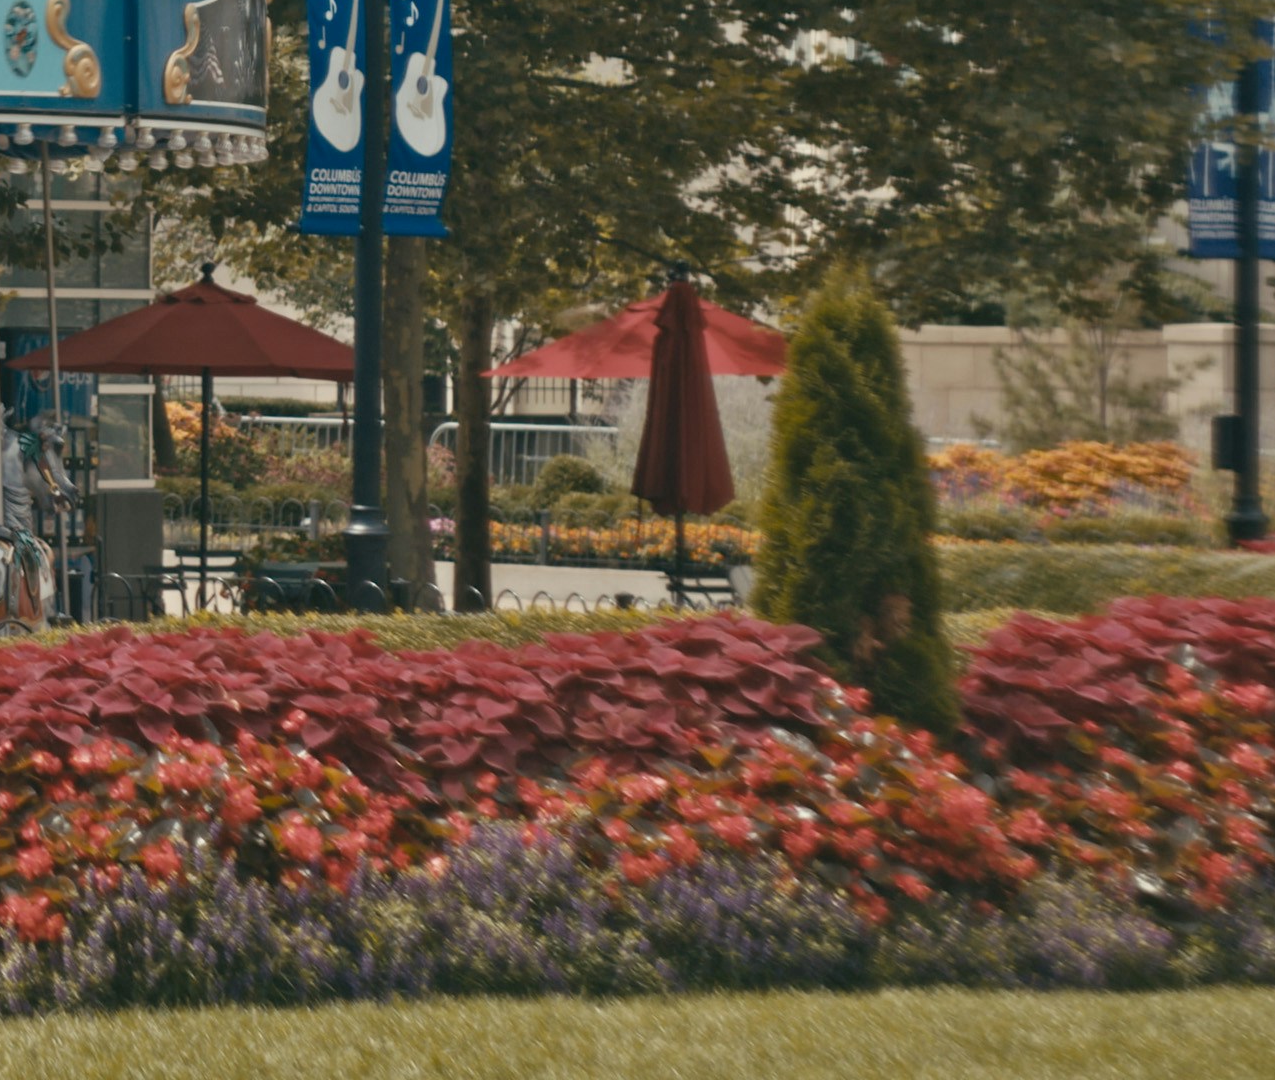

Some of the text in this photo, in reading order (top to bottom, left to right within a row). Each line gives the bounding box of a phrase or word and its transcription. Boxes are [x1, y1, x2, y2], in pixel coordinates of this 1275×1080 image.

[311, 167, 362, 183] COLUMBUS
[390, 169, 447, 187] COLUMBUS
[309, 183, 361, 196] DOWNTOWN
[386, 184, 443, 199] DOWNTOWN
